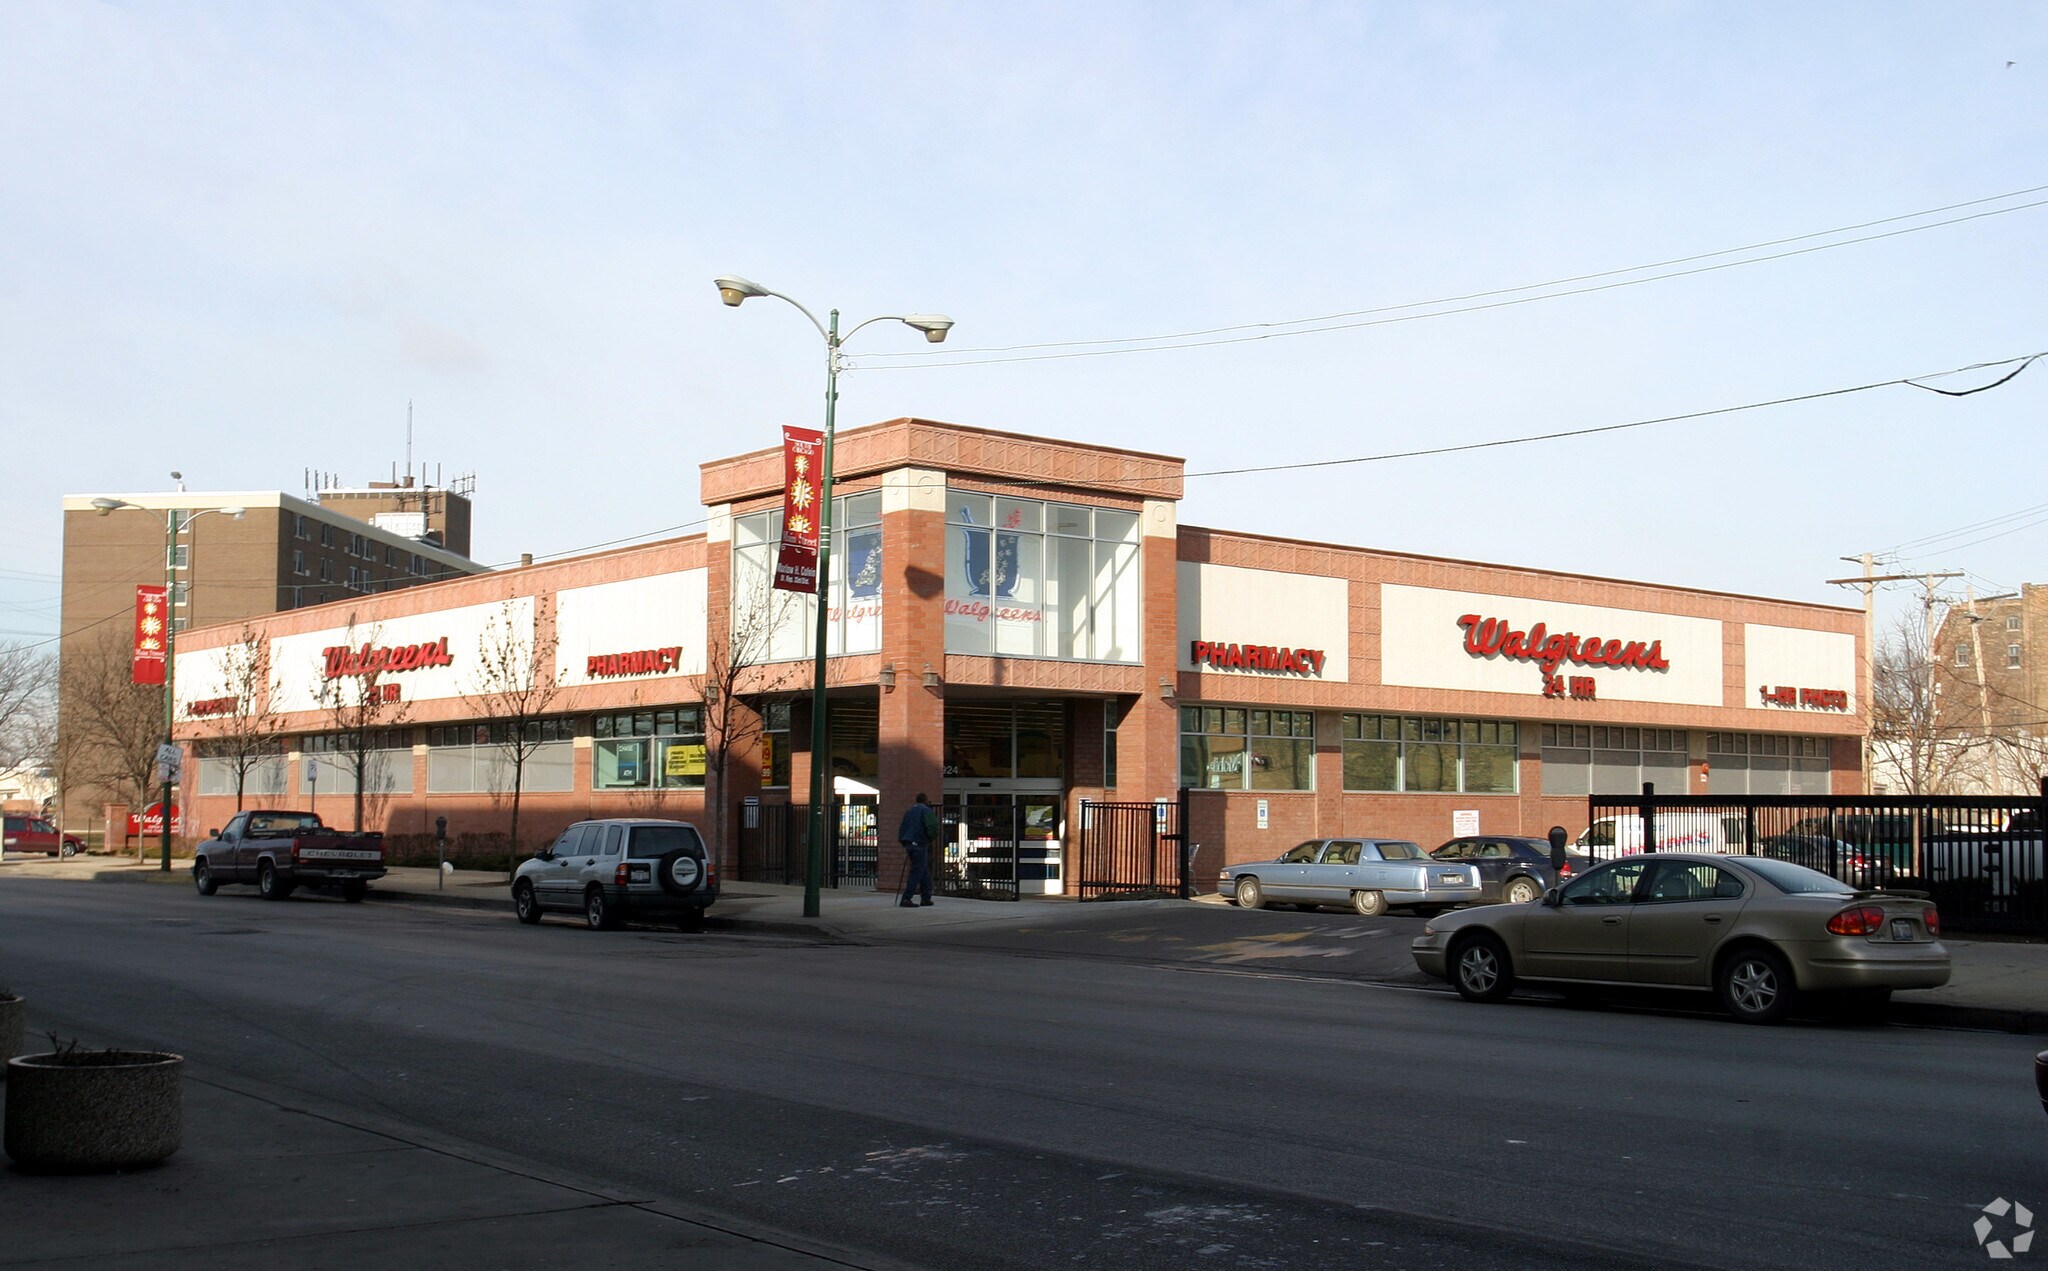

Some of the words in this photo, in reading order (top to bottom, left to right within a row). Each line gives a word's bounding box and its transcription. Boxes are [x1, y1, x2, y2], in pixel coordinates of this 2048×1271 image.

[783, 531, 797, 543] Main
[799, 533, 818, 546] Street
[322, 637, 454, 679] Walgreens
[1191, 640, 1325, 677] PHARMACY
[1456, 614, 1670, 674] Walgreens
[587, 646, 683, 679] PHARMACY
[1542, 674, 1565, 698] 24
[1569, 675, 1597, 700] HR
[164, 747, 176, 755] ALL
[307, 850, 373, 859] CHEVROLET
